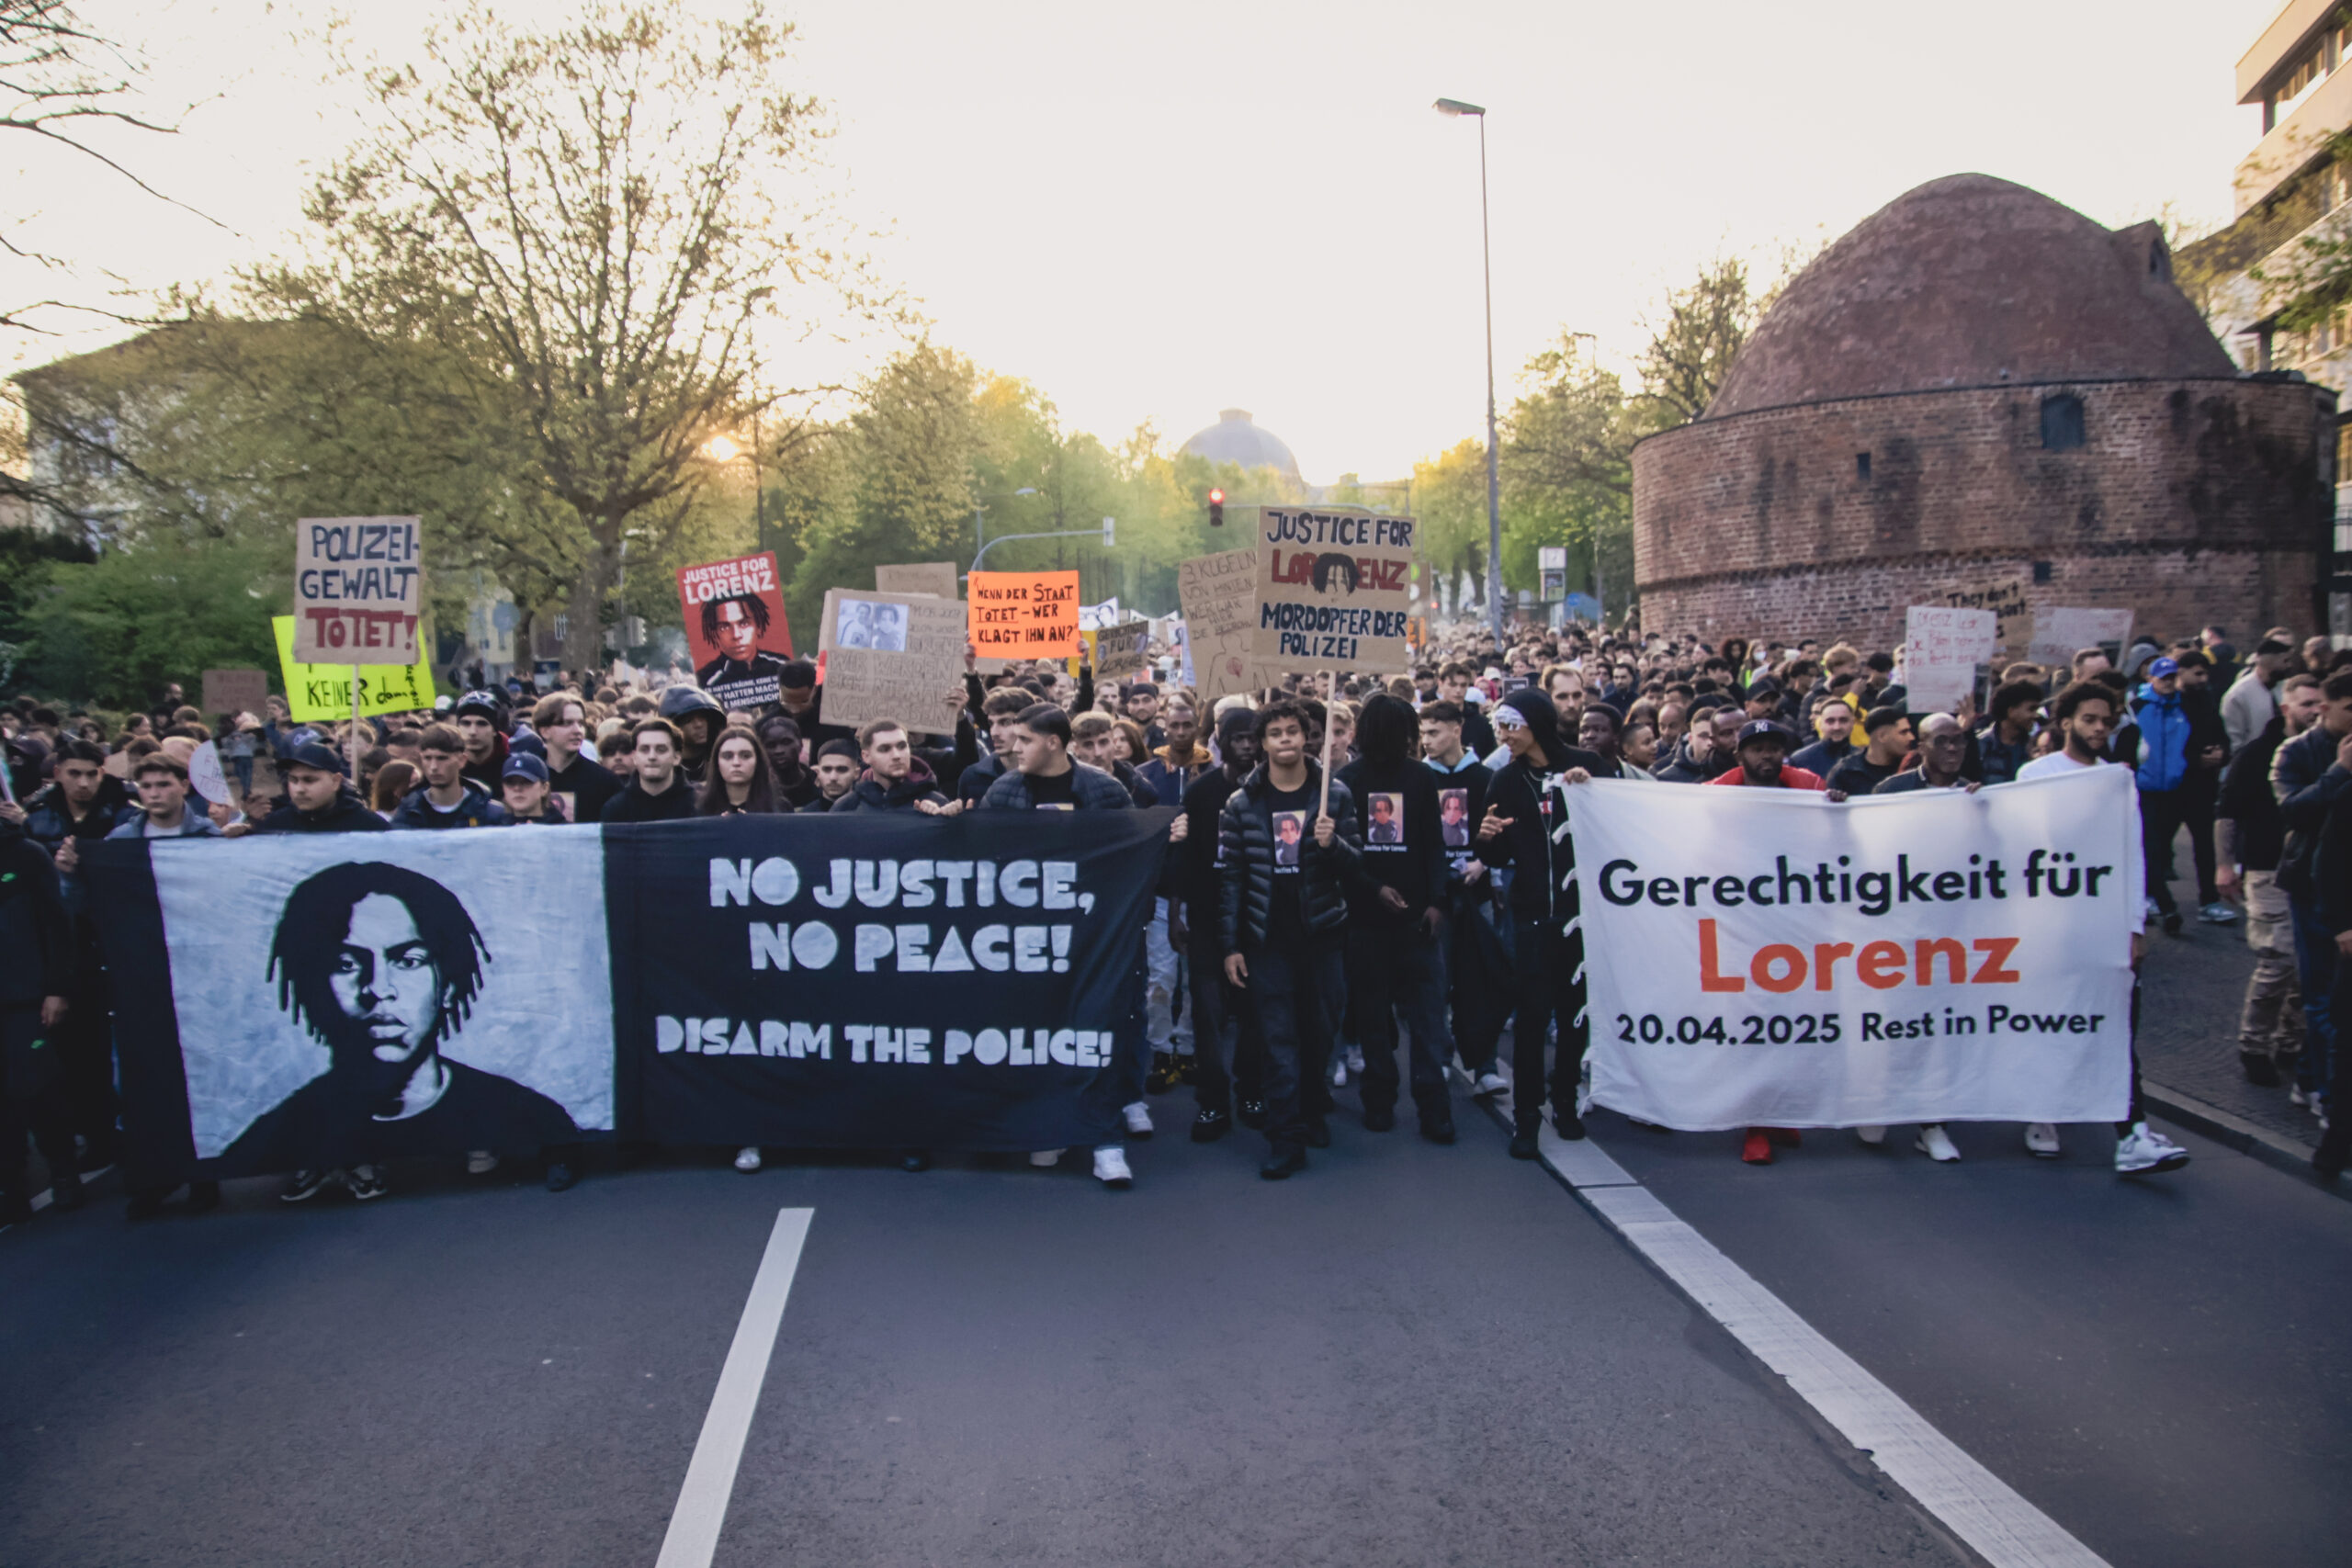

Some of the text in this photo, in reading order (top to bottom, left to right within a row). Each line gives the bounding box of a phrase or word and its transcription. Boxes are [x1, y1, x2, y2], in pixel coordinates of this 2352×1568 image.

[1266, 512, 1412, 547] JUSTICE FOR
[683, 557, 769, 584] JUSTICE FOR
[1198, 551, 1257, 578] KUGELN
[300, 566, 419, 601] GEWALT
[684, 570, 775, 605] LORENZ
[1007, 587, 1027, 600] DER
[1034, 583, 1073, 602] STAAT
[1033, 604, 1058, 618] WER
[1261, 603, 1370, 636] MORDOPFER
[1374, 610, 1408, 637] DER
[978, 629, 1021, 643] KLAGT
[1025, 627, 1045, 642] IHN
[1280, 632, 1357, 660] POLIZEI
[830, 652, 952, 682] WIR WERDEN
[307, 677, 369, 707] KEINER
[724, 688, 753, 700] HATTEN
[754, 682, 780, 694] MACH
[709, 856, 1095, 916] NO JUSTICE,
[1599, 849, 2112, 916] Gerechtigkeit für
[749, 919, 1073, 974] NO PEACE!
[1698, 919, 2020, 993] Lorenz
[656, 1015, 1114, 1067] DISARM THE POLICE!
[1616, 1005, 2106, 1045] 20.04.2025 Rest in Power
